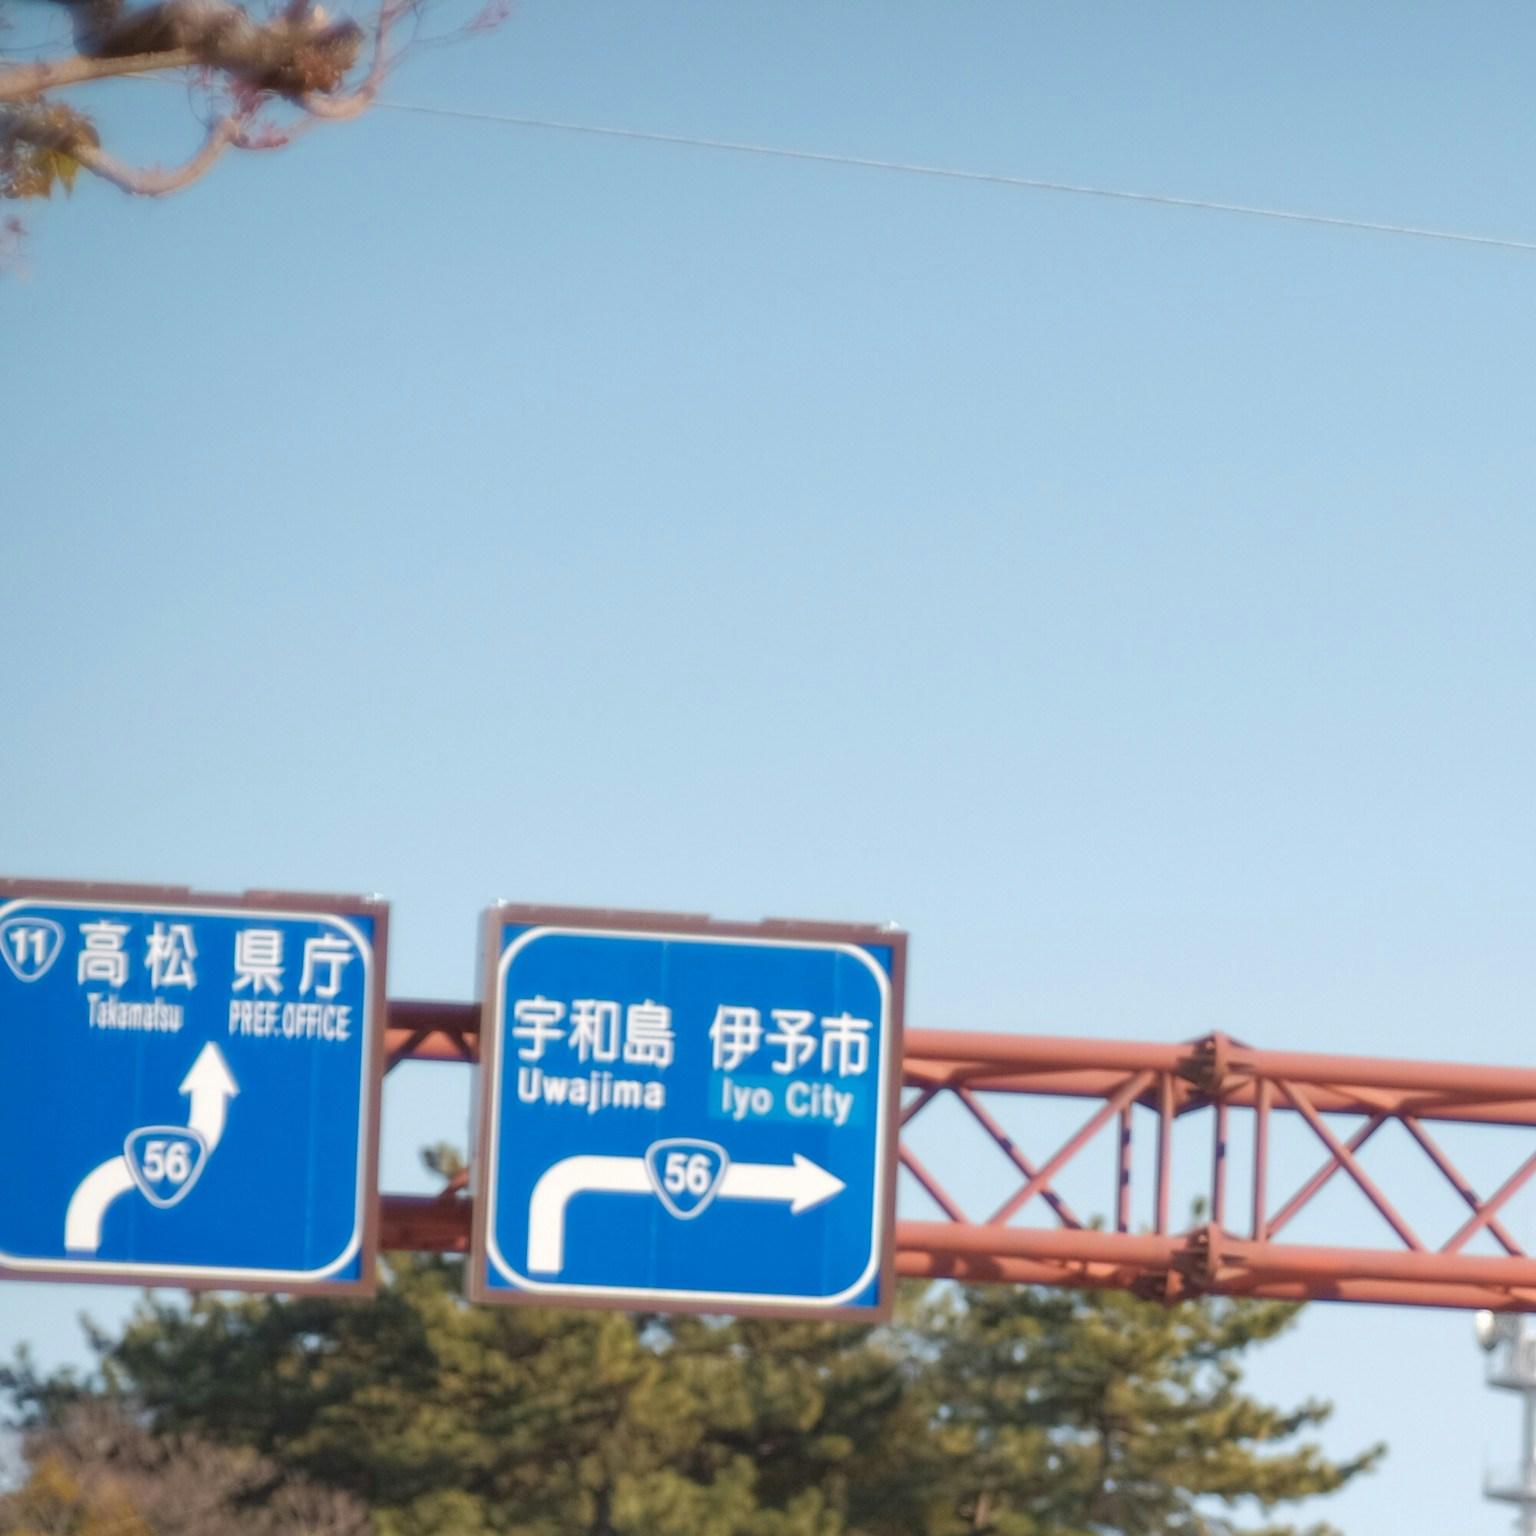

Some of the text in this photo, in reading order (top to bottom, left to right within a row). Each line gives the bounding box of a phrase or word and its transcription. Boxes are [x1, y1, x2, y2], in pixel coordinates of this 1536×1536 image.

[9, 929, 46, 965] 11
[77, 921, 356, 998] 高松 県庁
[87, 993, 184, 1033] Takamatsu
[512, 996, 873, 1077] 宇和島 伊予市
[517, 1067, 854, 1126] Uwajima Iyo City
[142, 1140, 191, 1183] 56
[664, 1153, 712, 1194] 56
